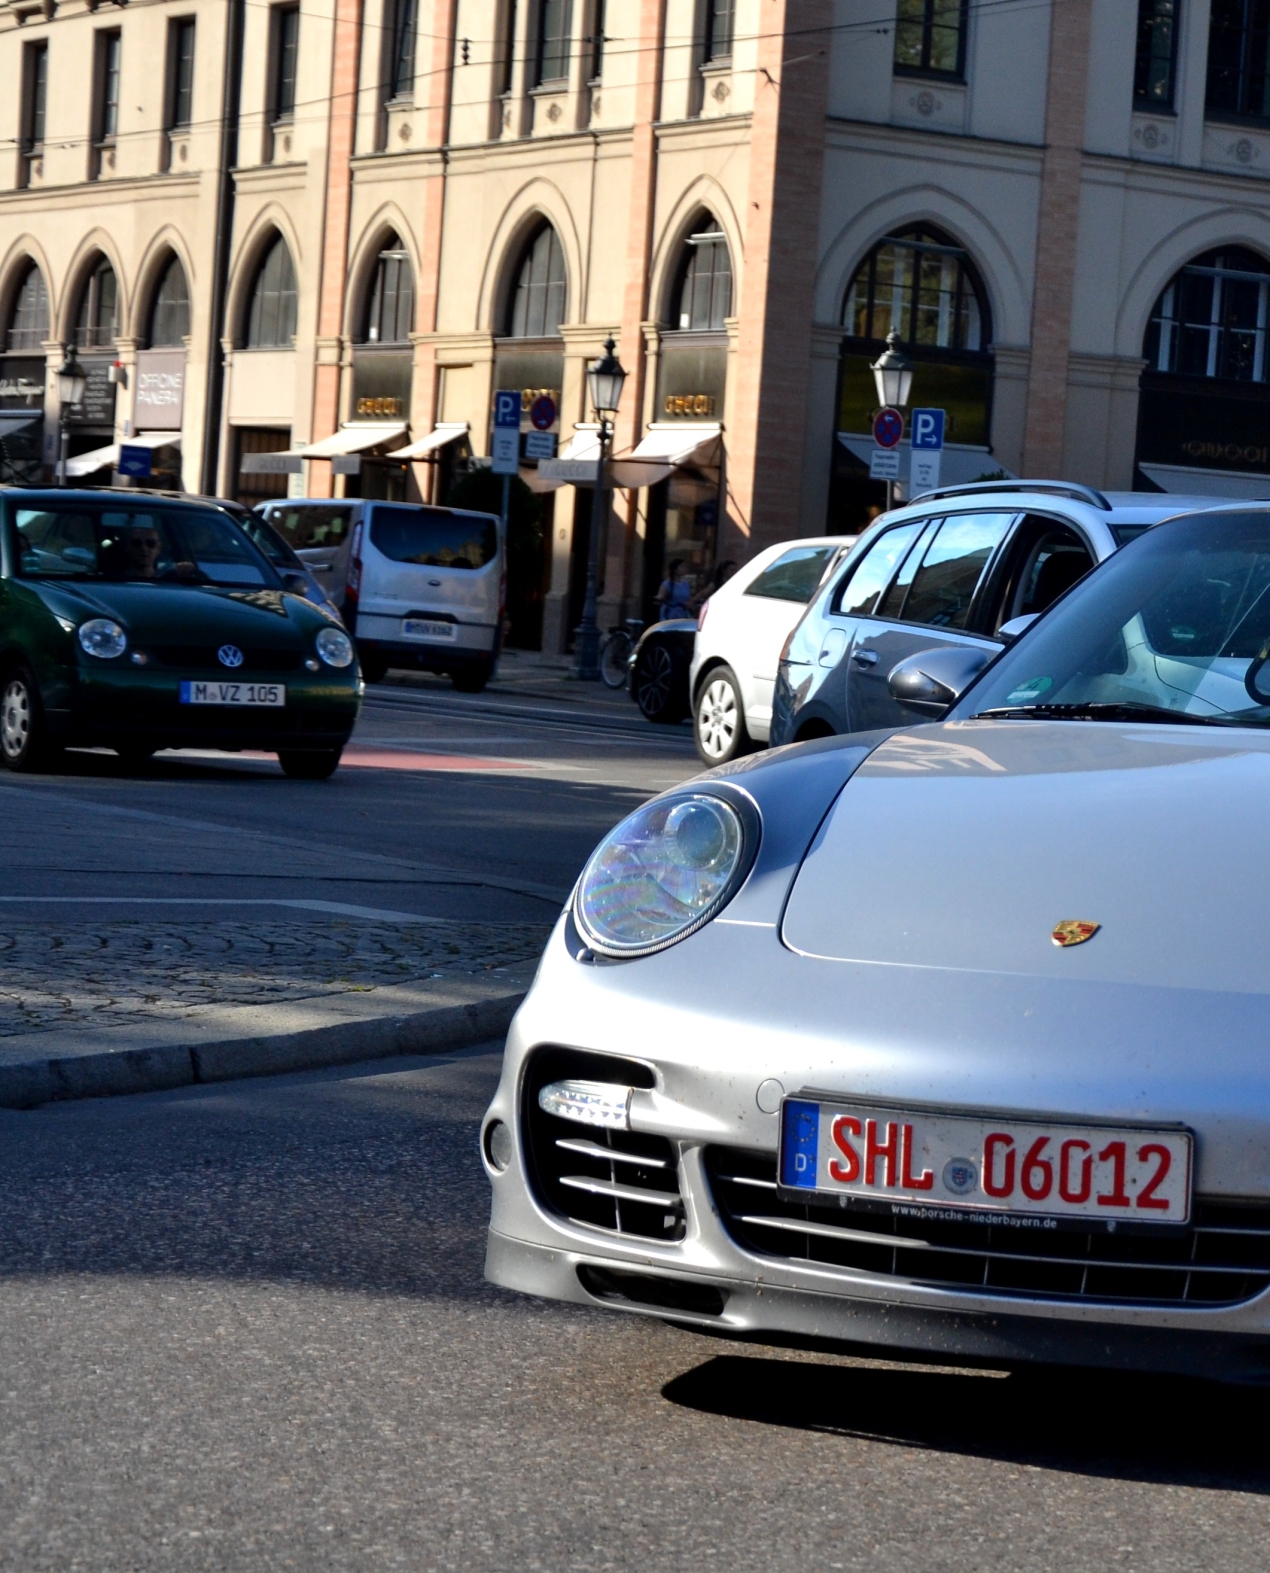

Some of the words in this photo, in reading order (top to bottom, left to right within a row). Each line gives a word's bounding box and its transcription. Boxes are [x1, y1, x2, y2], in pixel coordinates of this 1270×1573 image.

[498, 396, 514, 422] P
[916, 414, 935, 444] P
[195, 684, 207, 701] M
[219, 685, 240, 702] VZ
[247, 686, 278, 703] 105
[795, 1153, 807, 1172] D
[828, 1115, 933, 1190] SHL
[982, 1132, 1172, 1209] 06012
[891, 1203, 1058, 1229] www.porsche-niederbayern.de
